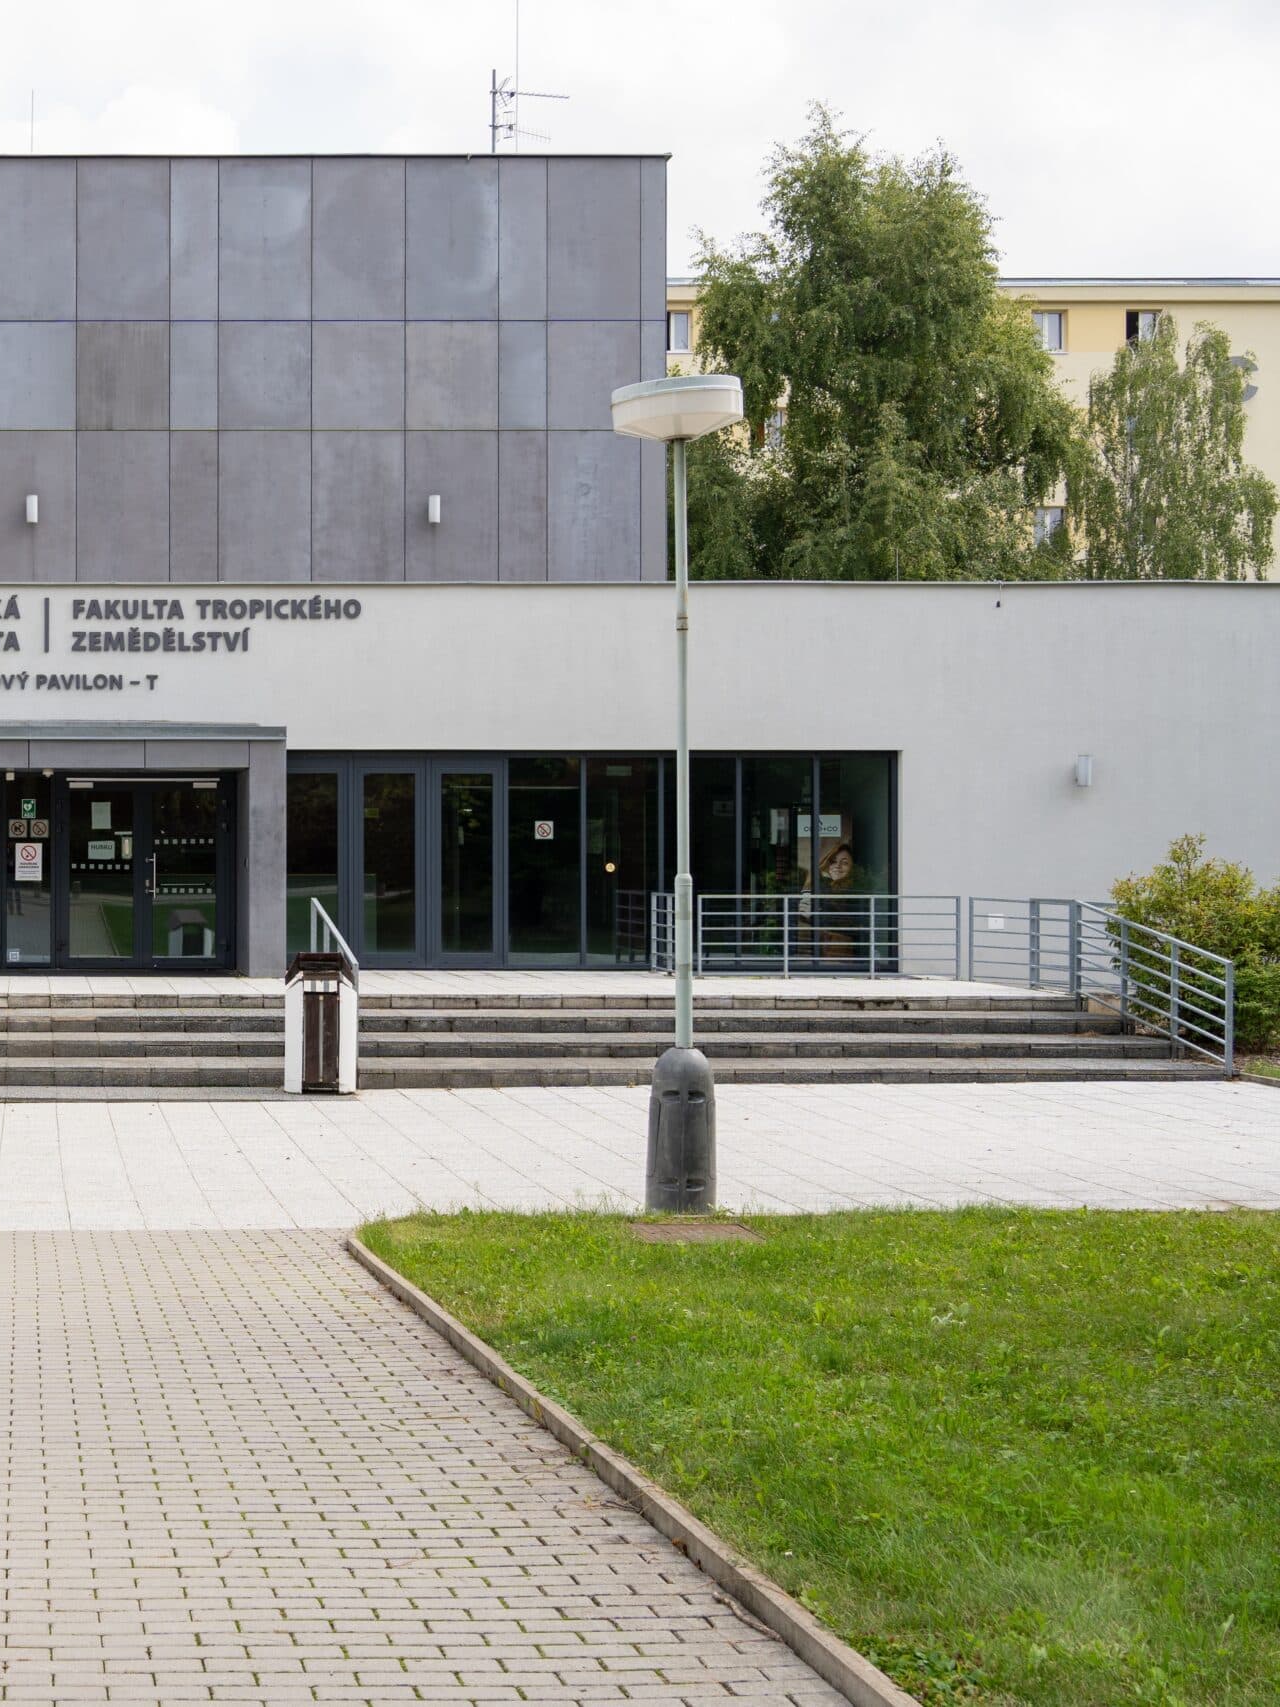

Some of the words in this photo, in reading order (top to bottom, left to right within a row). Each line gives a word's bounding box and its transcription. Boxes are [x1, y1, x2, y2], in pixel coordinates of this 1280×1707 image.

[72, 598, 184, 620] FAKULTA
[196, 593, 362, 621] TROPICKÉHO
[70, 626, 251, 653] ZEMĚDĚLSTVÍ
[35, 673, 124, 691] PAVILON
[145, 674, 159, 691] T
